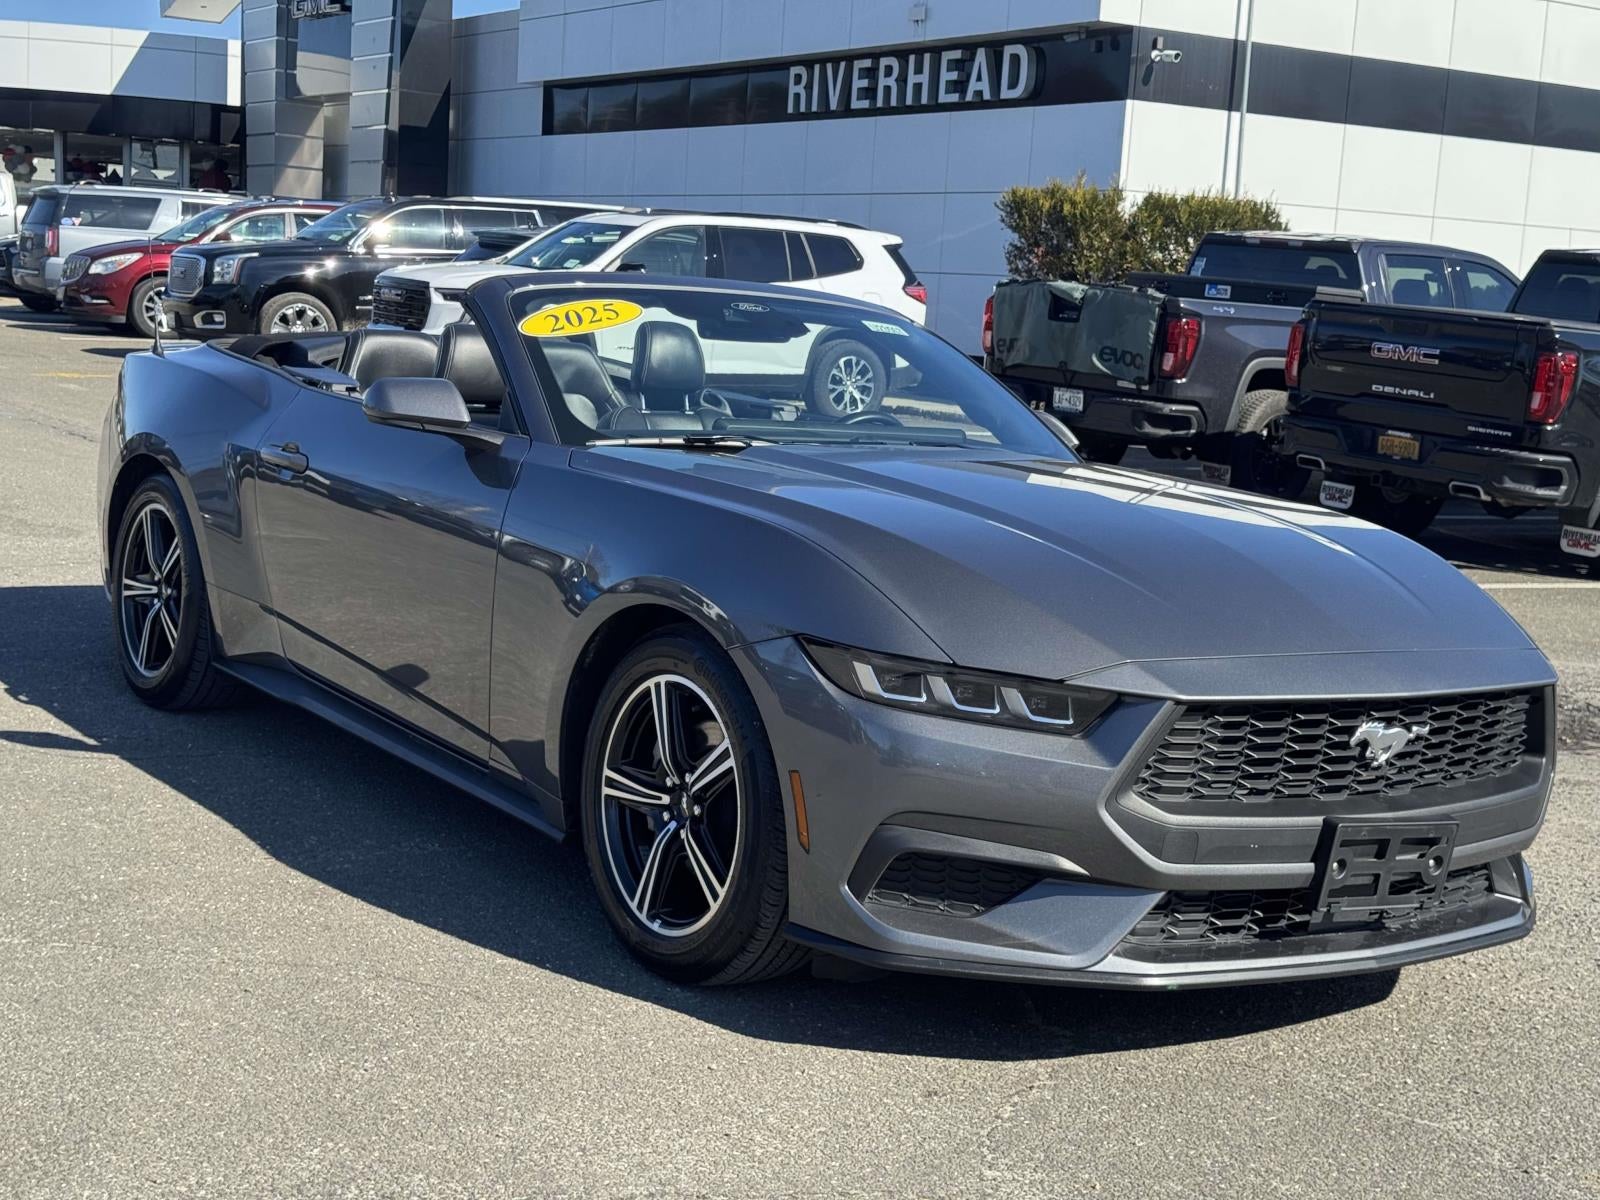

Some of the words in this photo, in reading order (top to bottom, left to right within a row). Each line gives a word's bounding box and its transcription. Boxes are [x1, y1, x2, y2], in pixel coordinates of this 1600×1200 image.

[787, 43, 1033, 114] RIVERHEAD
[543, 303, 620, 333] 2025
[1100, 345, 1144, 370] evoc
[1370, 341, 1440, 365] GMC
[1371, 384, 1435, 399] DENALI
[1567, 538, 1597, 552] GMC
